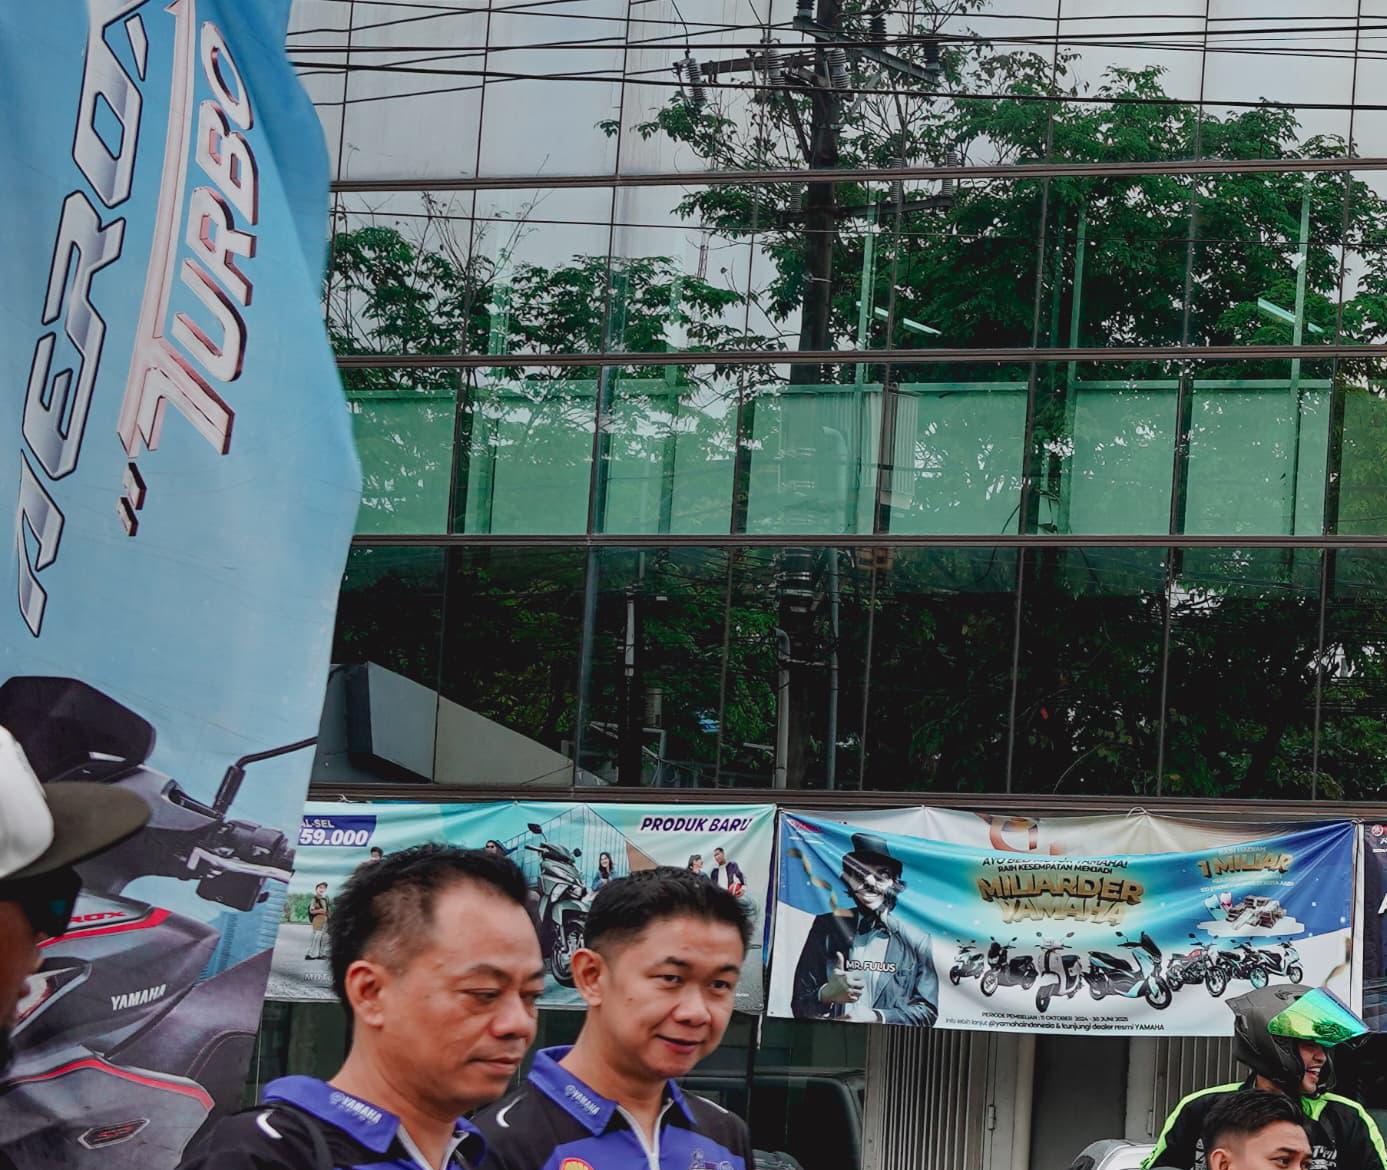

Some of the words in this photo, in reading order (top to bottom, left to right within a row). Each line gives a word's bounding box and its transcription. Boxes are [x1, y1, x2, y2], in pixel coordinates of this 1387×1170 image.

[641, 818, 707, 832] PRODUK
[709, 818, 753, 832] BARU
[300, 829, 368, 845] 59.000
[998, 865, 1017, 873] RAIH
[1018, 863, 1072, 871] KESEMPATAN
[1074, 866, 1112, 875] MENJADI
[1213, 853, 1294, 875] MILIAR
[978, 874, 1145, 906] MILIARDER
[70, 911, 127, 924] ROX
[997, 898, 1127, 927] YAMAHA
[863, 961, 897, 973] FULUS
[111, 983, 167, 1011] YAMAHA
[342, 1095, 383, 1124] YAMAHA
[572, 1088, 600, 1116] YAMAHA
